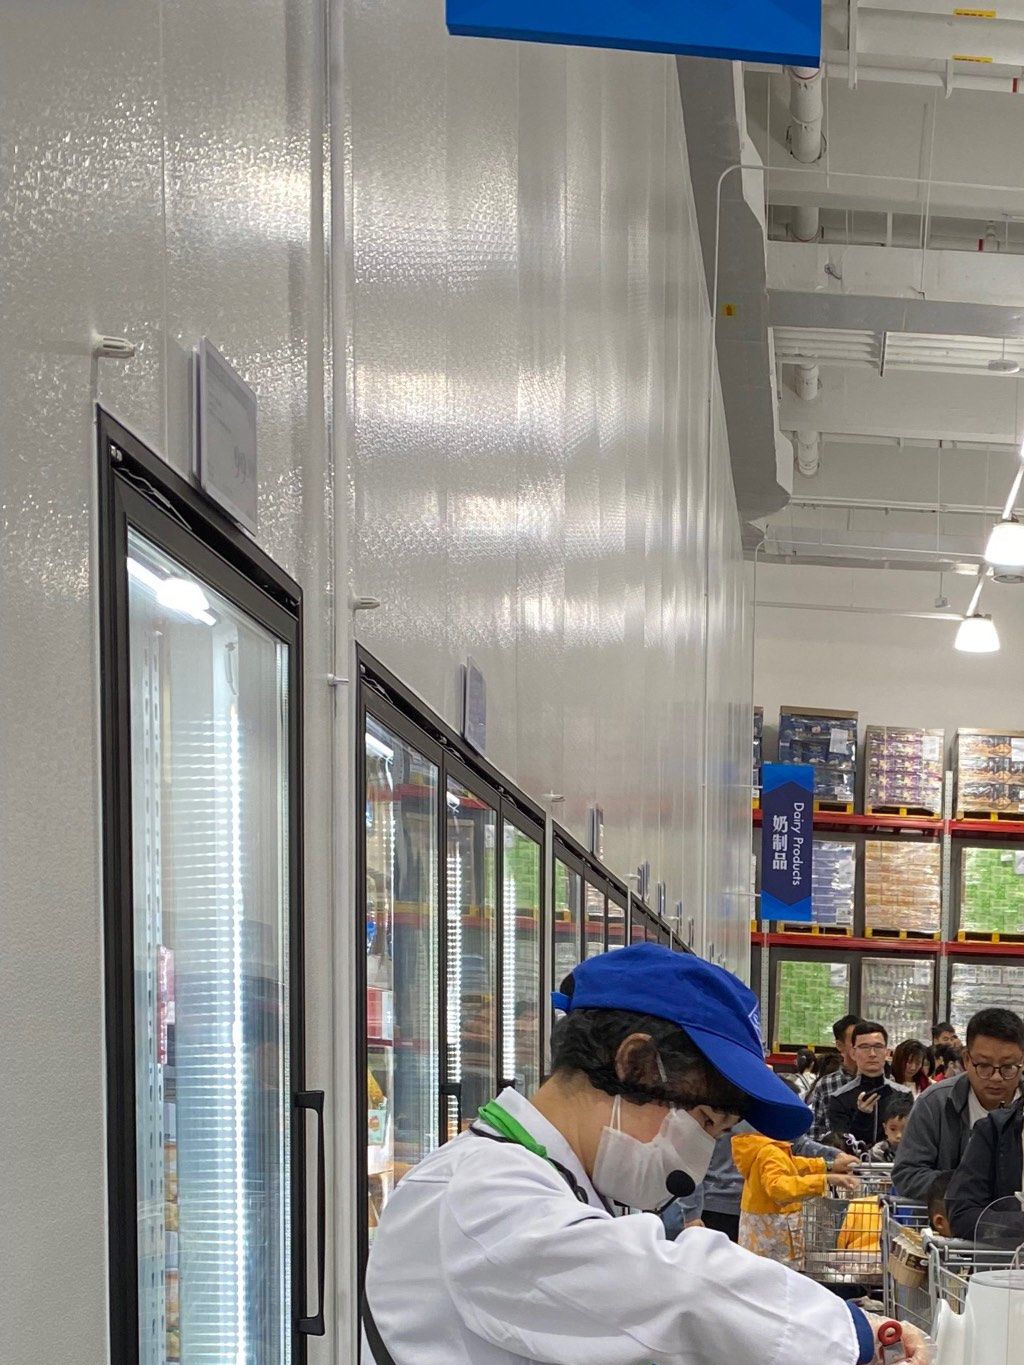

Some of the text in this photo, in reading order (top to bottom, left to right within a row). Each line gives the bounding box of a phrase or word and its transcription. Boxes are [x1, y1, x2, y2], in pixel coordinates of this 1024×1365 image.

[772, 814, 789, 871] 奶制品
[791, 802, 805, 886] Dairy Products
